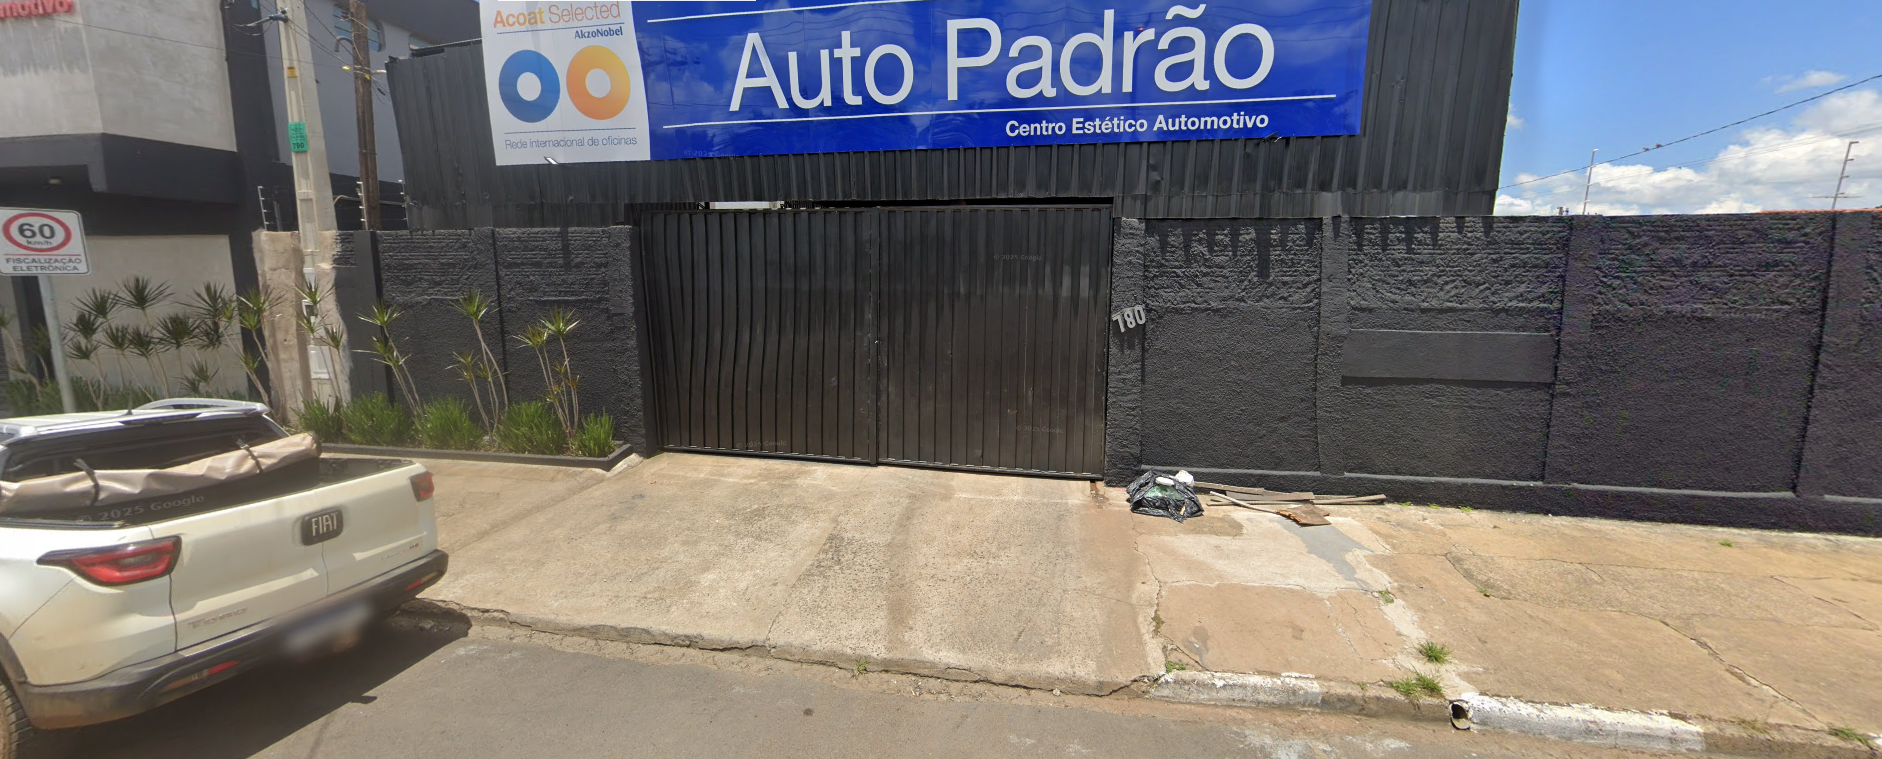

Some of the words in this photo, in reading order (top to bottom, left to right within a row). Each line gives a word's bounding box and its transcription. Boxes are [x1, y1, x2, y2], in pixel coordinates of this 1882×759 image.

[493, 7, 546, 28] Acoat
[548, 2, 621, 24] Selected
[574, 26, 624, 39] AkzoNobel
[729, 30, 915, 112] Auto
[946, 3, 1275, 101] Padrão
[1005, 119, 1066, 137] Centro
[1071, 116, 1148, 135] Estético
[1152, 112, 1269, 132] Automotivo
[504, 139, 528, 150] Rede
[529, 137, 585, 149] internacional
[587, 136, 600, 147] de
[601, 135, 638, 146] oficinas
[18, 222, 56, 240] 60
[6, 257, 82, 265] FISCALIZAÇÃO
[1111, 305, 1146, 333] 780
[311, 511, 339, 537] FIAT
